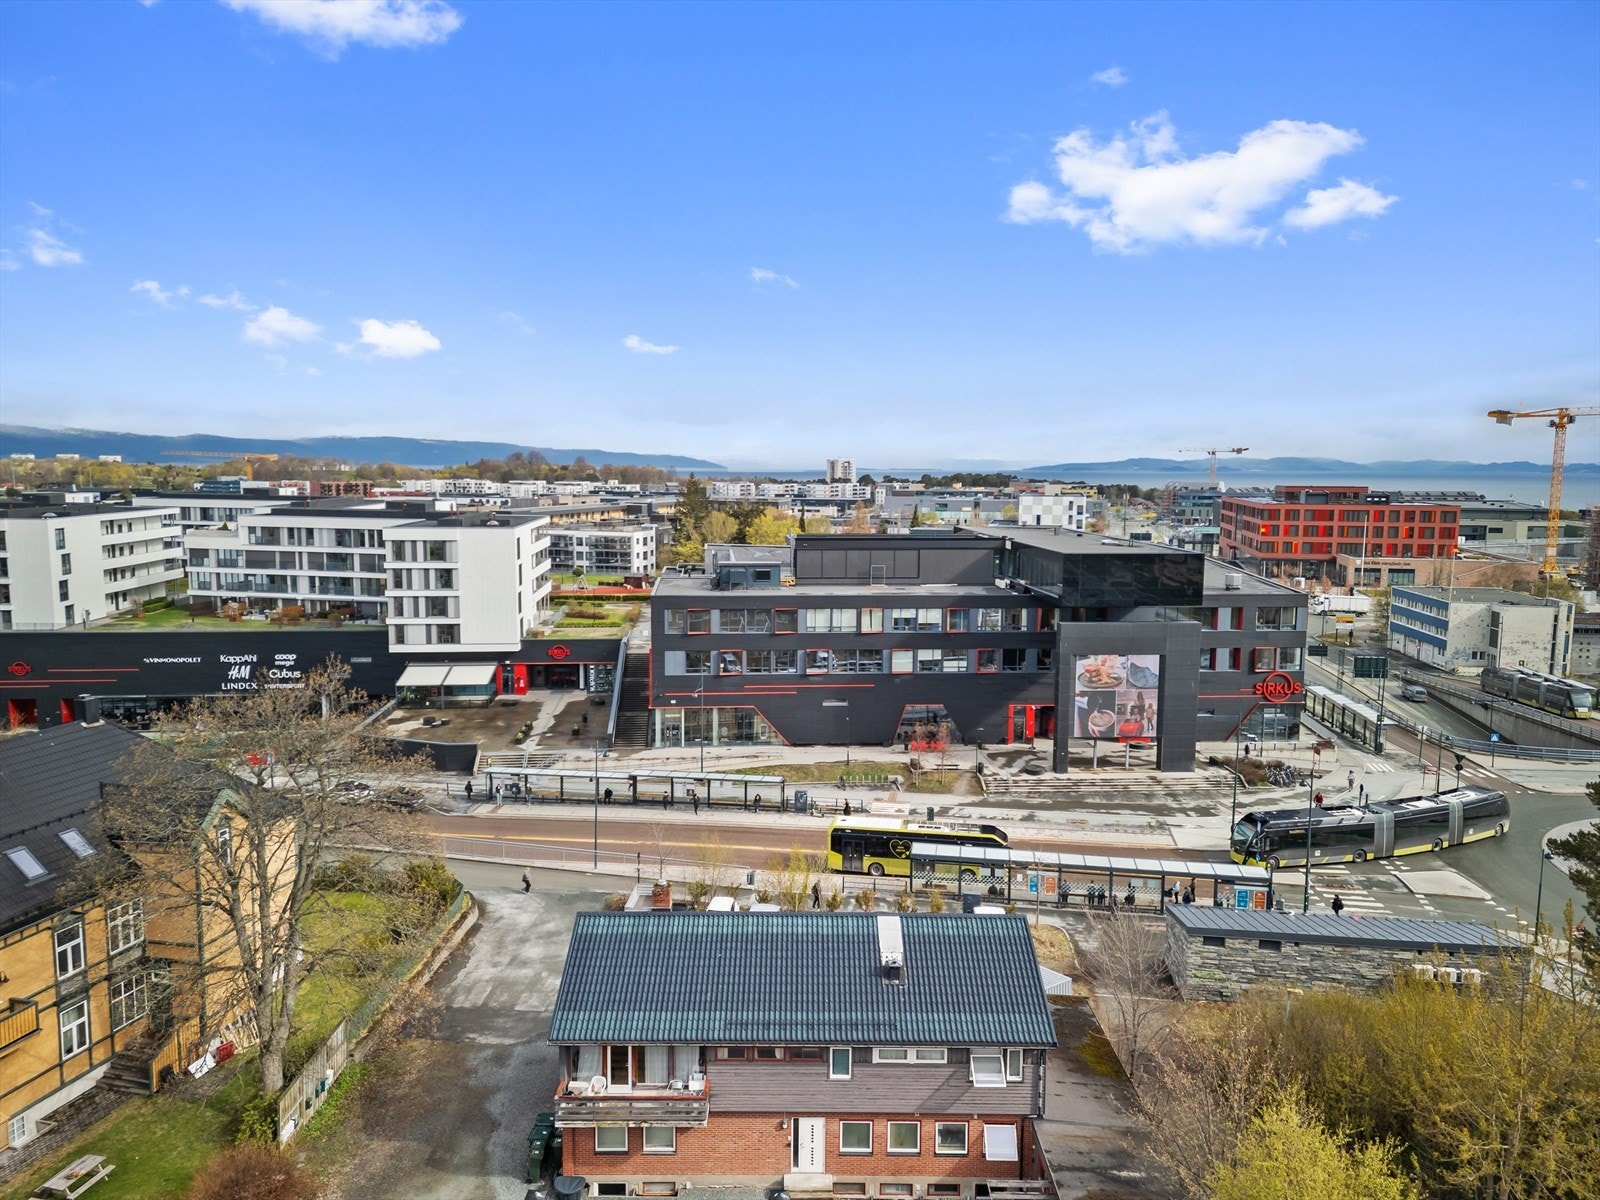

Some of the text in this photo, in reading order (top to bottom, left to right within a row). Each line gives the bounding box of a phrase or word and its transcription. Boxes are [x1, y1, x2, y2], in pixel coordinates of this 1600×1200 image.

[220, 654, 257, 664] KappAhl
[274, 653, 297, 661] coop
[228, 665, 251, 680] H&M
[269, 668, 301, 679] Cubus
[221, 682, 258, 690] LINDEX
